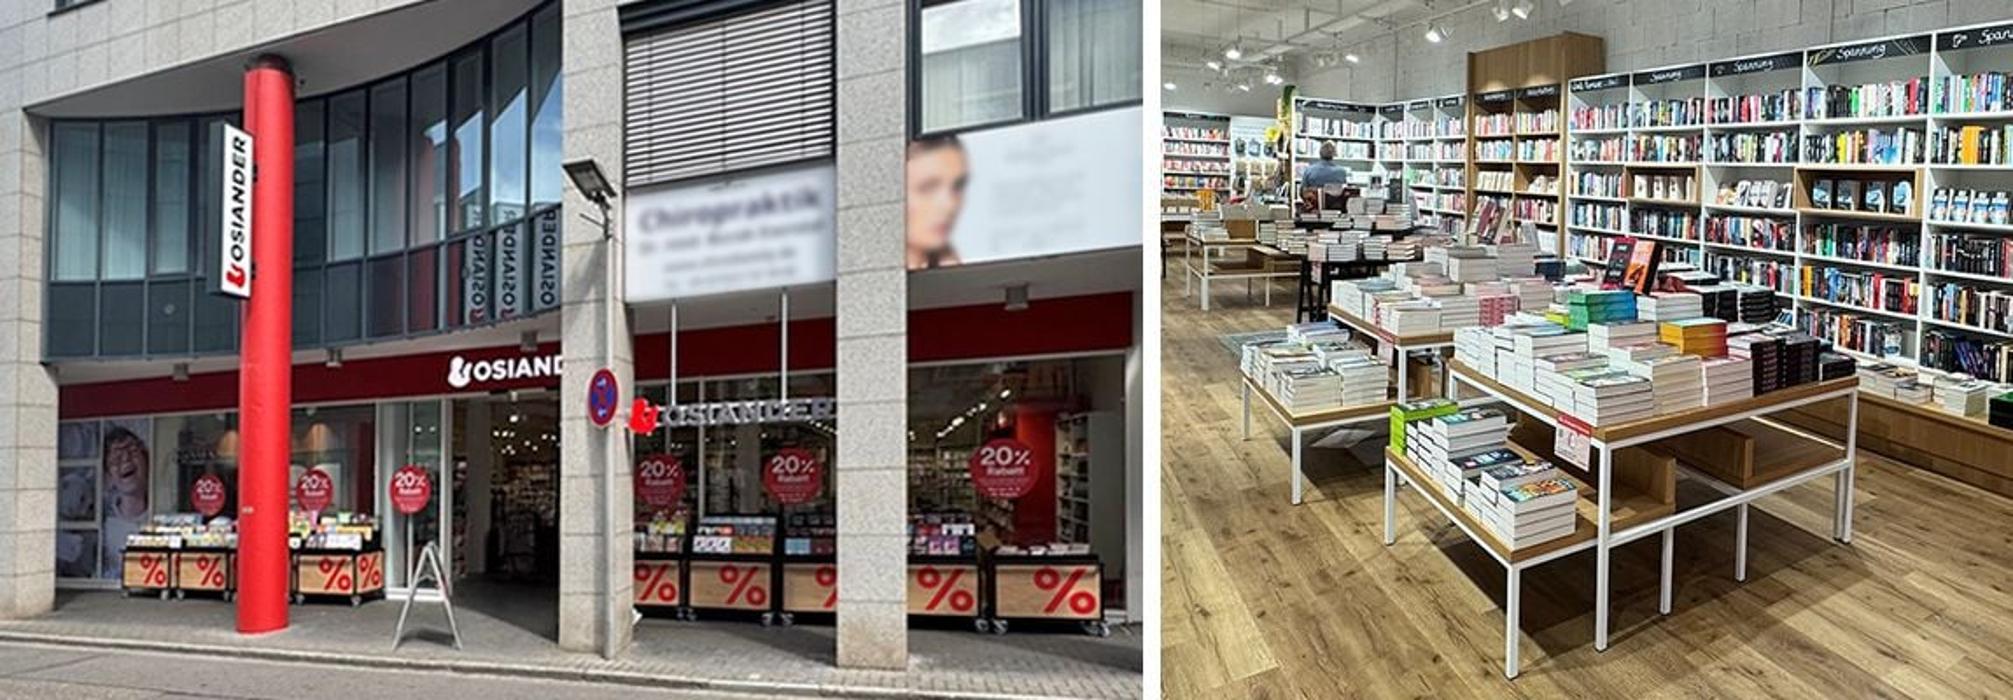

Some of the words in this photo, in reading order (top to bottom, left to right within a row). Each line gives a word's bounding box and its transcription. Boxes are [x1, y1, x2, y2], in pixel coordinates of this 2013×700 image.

[1835, 44, 1887, 60] Spannung
[230, 136, 247, 262] OSIANDER
[772, 455, 815, 474] 20%
[981, 446, 1031, 467] 20%
[641, 460, 679, 478] 20%
[395, 471, 427, 488] 20%
